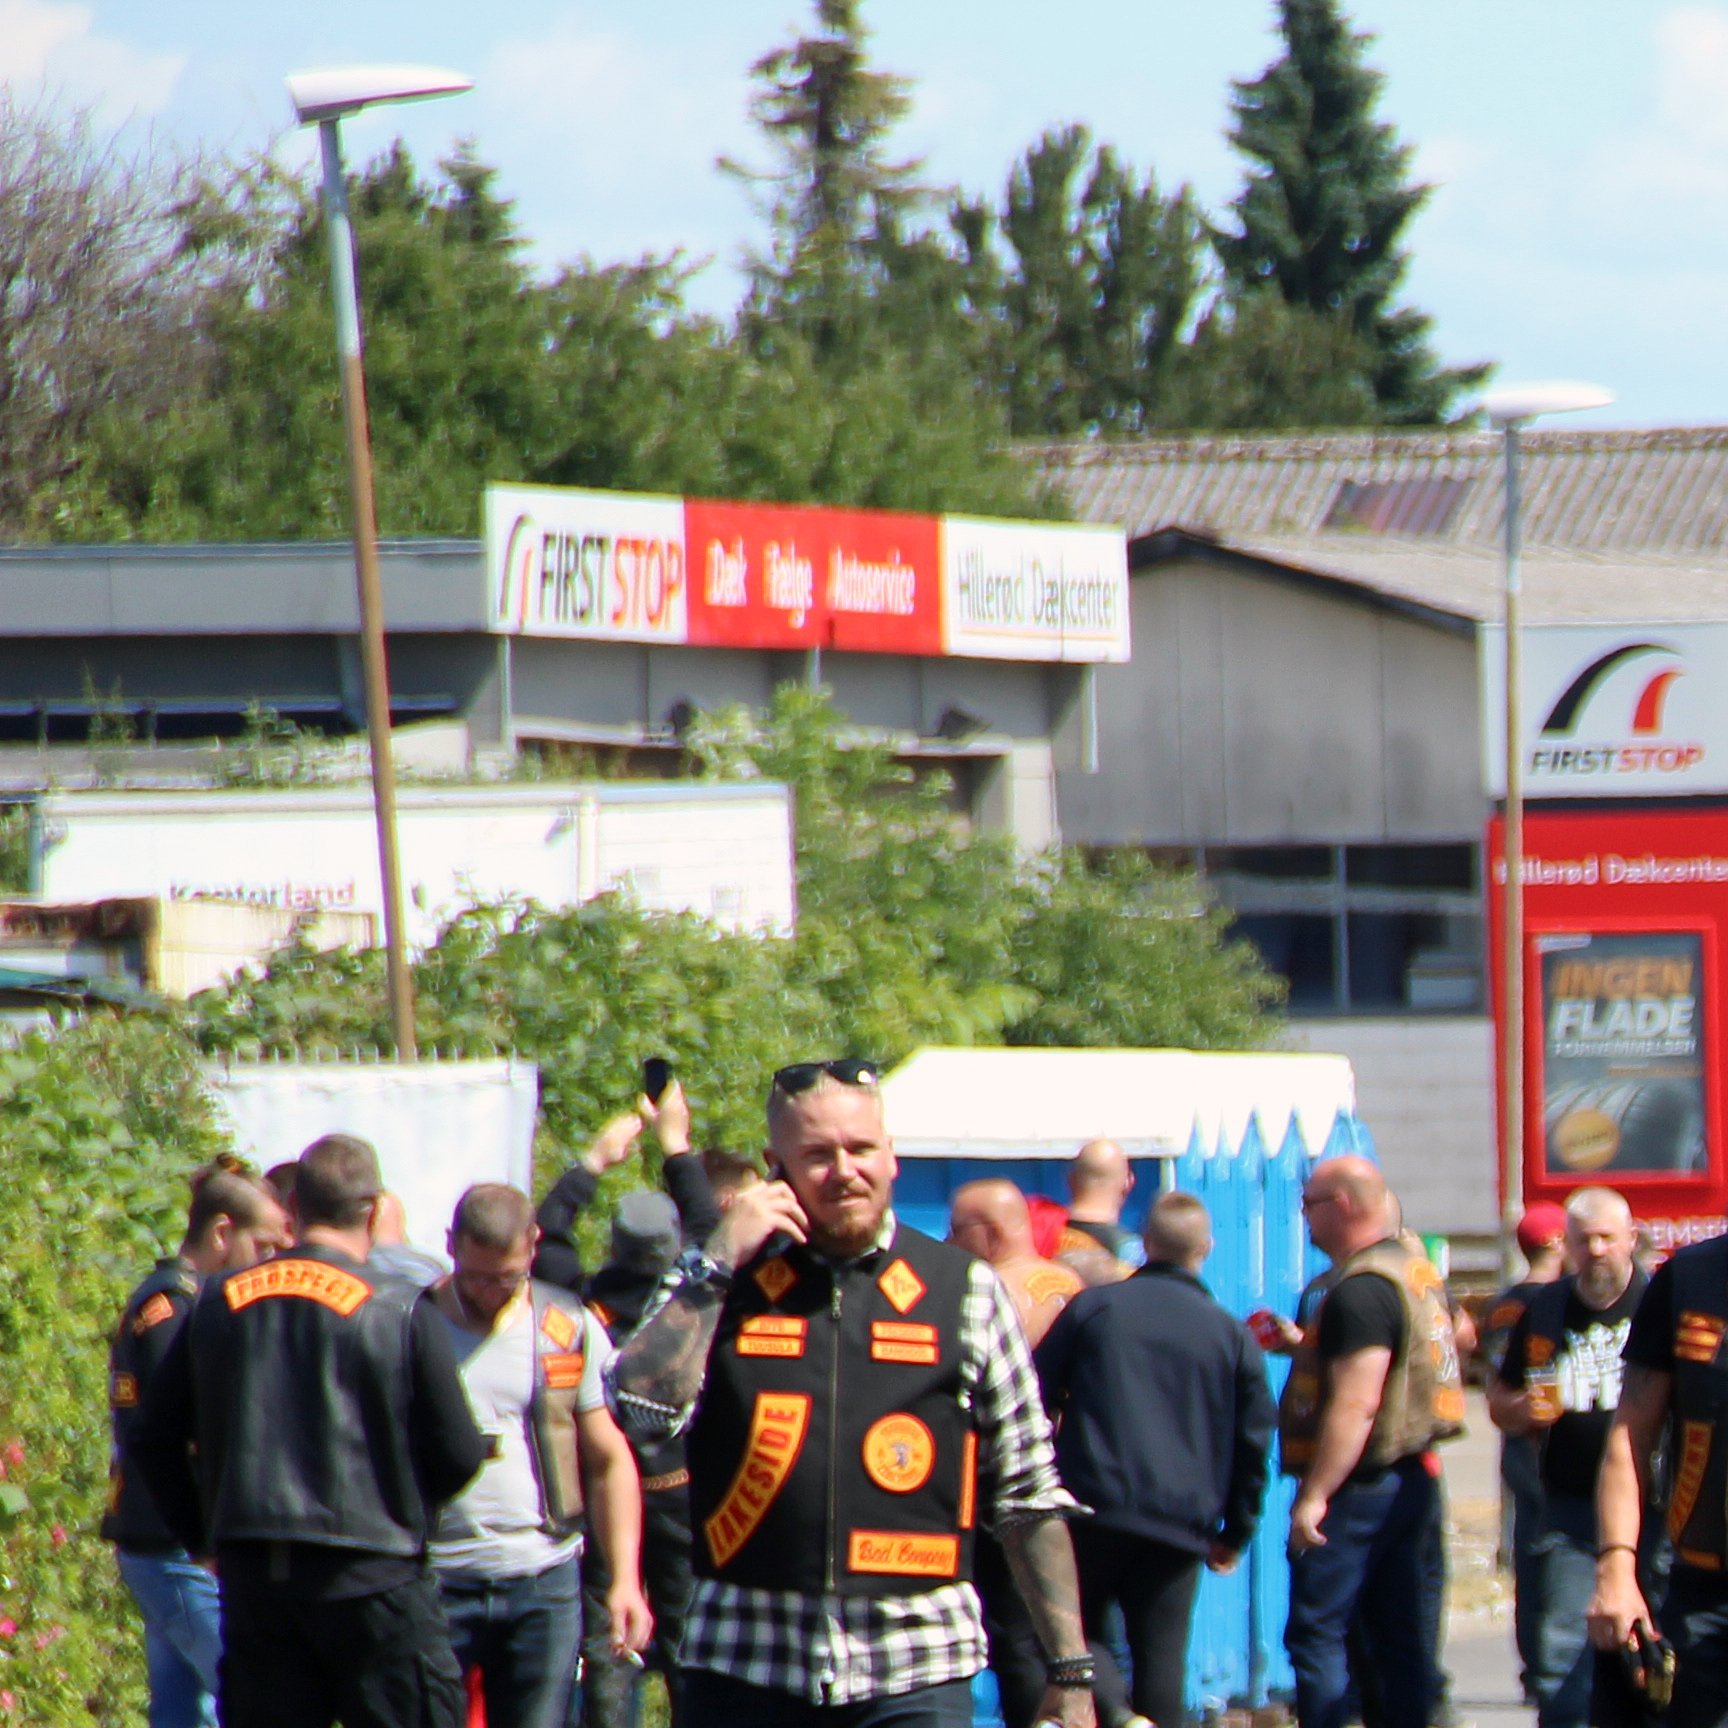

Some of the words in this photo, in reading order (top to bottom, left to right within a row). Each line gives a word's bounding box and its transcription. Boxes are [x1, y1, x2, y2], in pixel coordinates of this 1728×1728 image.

[829, 543, 916, 615] Autoservice
[958, 547, 1026, 622] Hillerød
[1031, 557, 1118, 627] Dækcenter
[1493, 854, 1599, 885] llerød
[1555, 959, 1694, 996] INGEN
[1553, 997, 1695, 1039] FLADE
